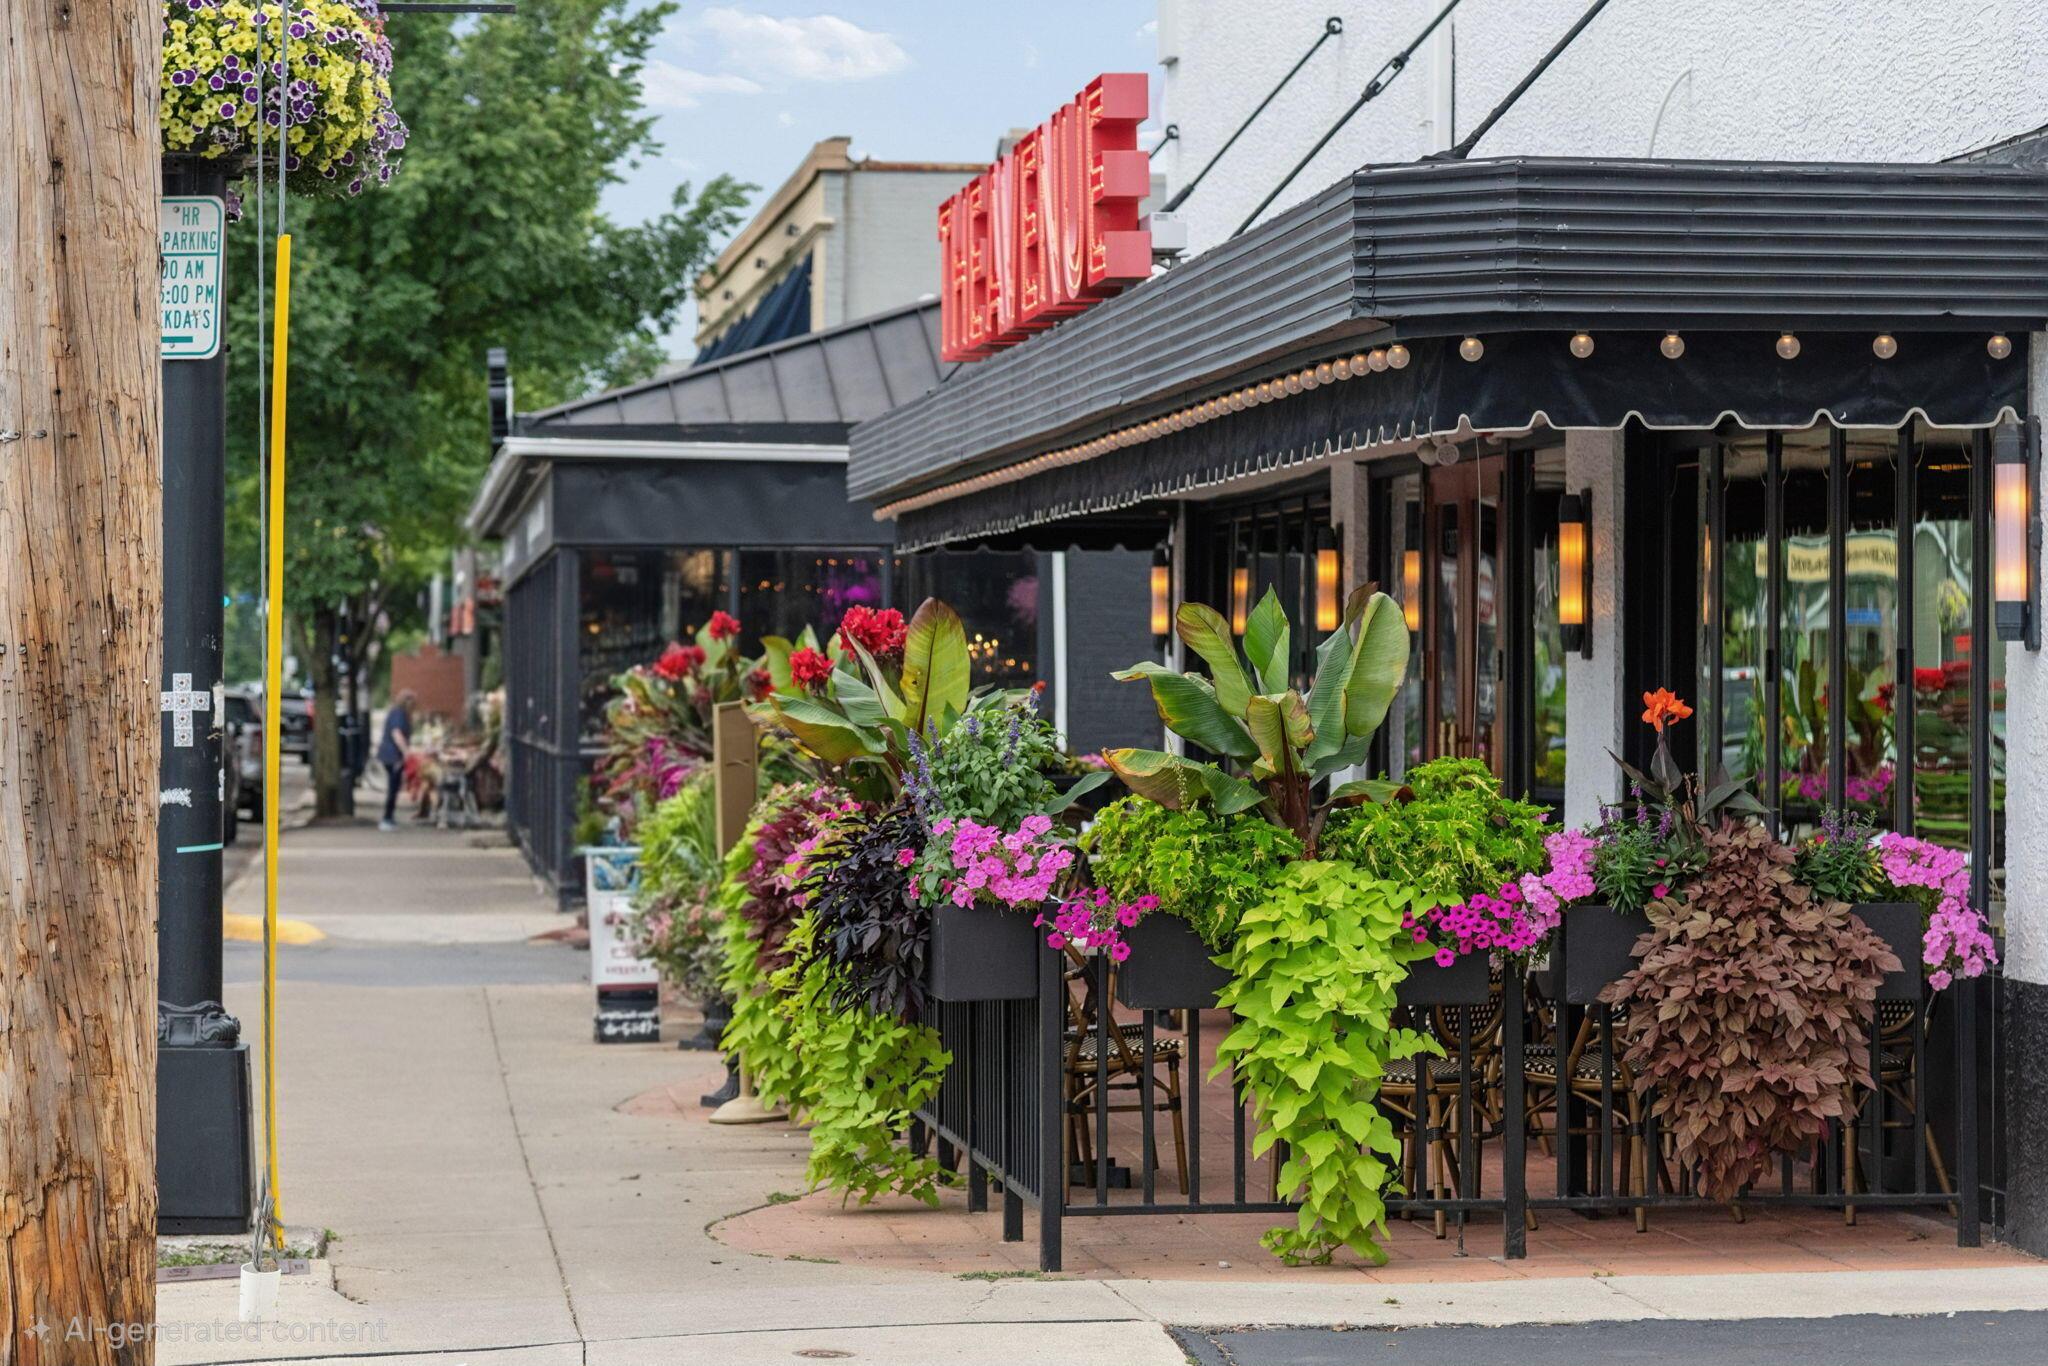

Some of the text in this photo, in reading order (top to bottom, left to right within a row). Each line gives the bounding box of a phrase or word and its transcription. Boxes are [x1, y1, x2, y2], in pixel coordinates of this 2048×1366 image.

[182, 207, 200, 226] HR
[164, 231, 217, 251] PARKING
[185, 260, 204, 279] AM
[195, 285, 214, 304] PM
[161, 309, 211, 329] KDAYS
